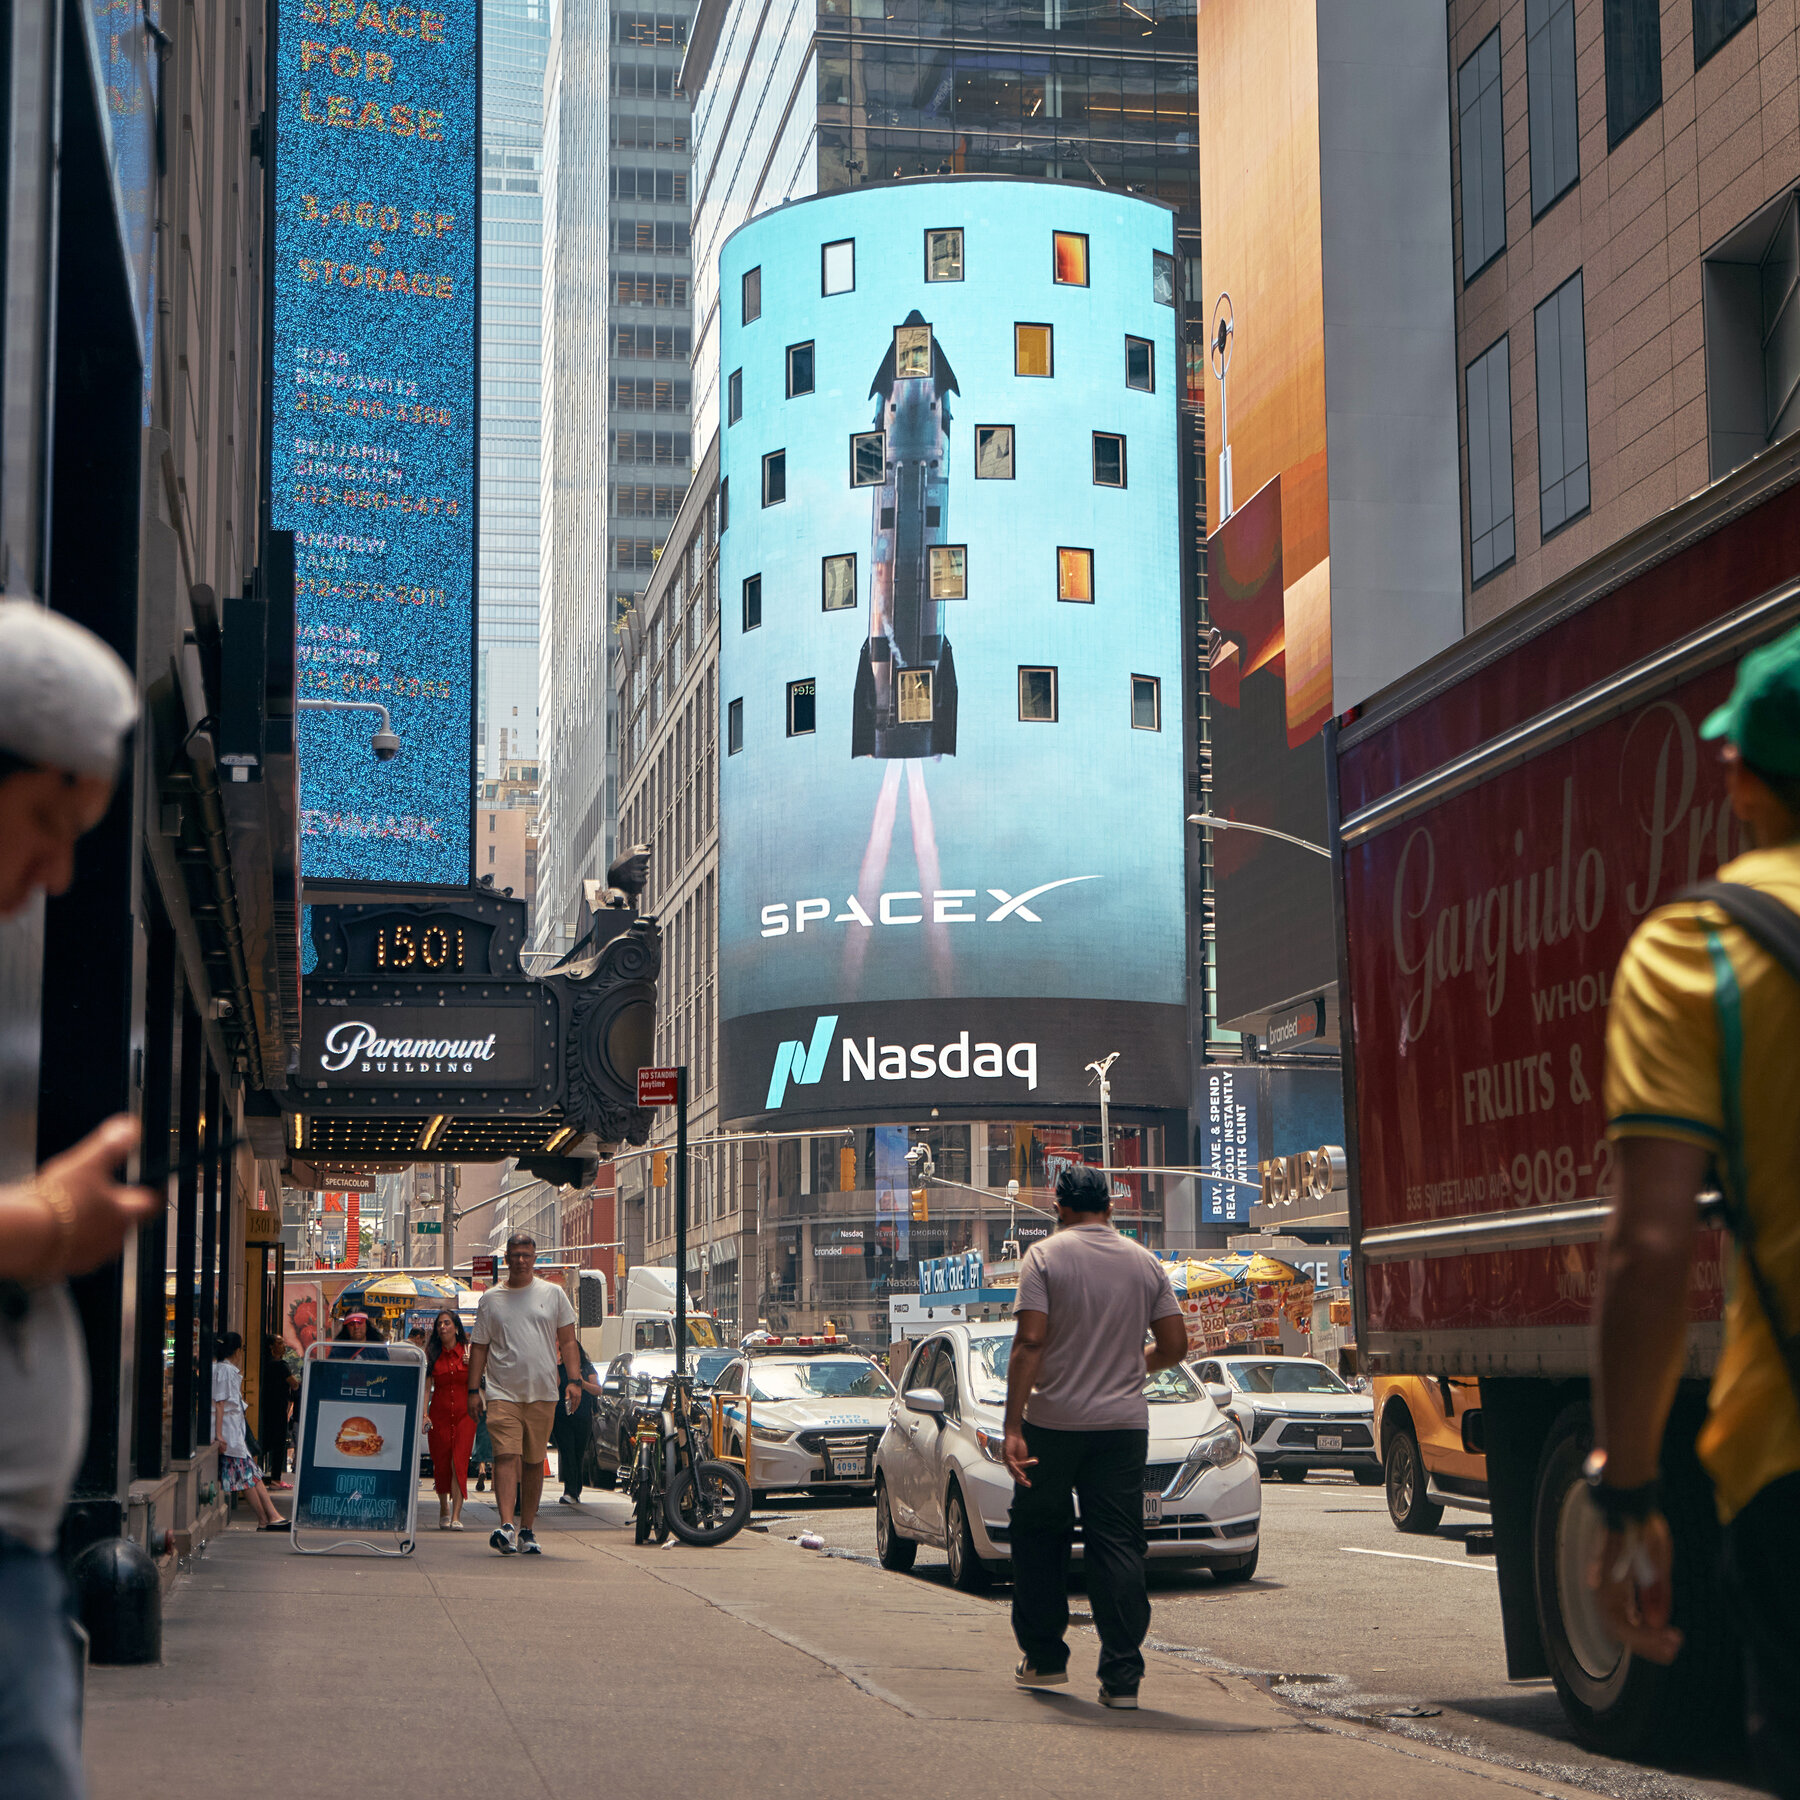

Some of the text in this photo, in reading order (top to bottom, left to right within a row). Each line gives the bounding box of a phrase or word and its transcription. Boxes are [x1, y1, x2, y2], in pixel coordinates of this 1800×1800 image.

[300, 0, 445, 43] SPACE
[300, 41, 393, 84] FOR
[301, 91, 444, 141] LEASE
[413, 212, 454, 238] SF
[299, 258, 453, 299] STORAGE
[295, 368, 419, 397] BERKOWITZ
[294, 437, 400, 463] BENJAMIN
[760, 875, 1104, 938] SPACEX
[377, 925, 464, 968] 1501
[1392, 827, 1606, 1042] Gargiulo
[320, 1021, 496, 1072] Paramount
[362, 1063, 474, 1073] BUILDING
[842, 1031, 1038, 1091] Nasdaq
[641, 1072, 649, 1080] NO
[641, 1081, 665, 1090] Anytime
[1462, 1044, 1591, 1126] FRUITS &
[1210, 1076, 1220, 1122] SPEND
[1211, 1126, 1220, 1135] &
[1223, 1071, 1236, 1220] REAL GOLD INSTANTLY
[1236, 1104, 1248, 1184] WITH GLINT
[325, 1178, 369, 1188] SPECTACOLOR
[1212, 1183, 1223, 1215] BUY,
[423, 1223, 428, 1232] 7
[841, 1230, 864, 1239] Nasdaq
[1018, 1228, 1047, 1237] Nasdaq
[367, 1295, 414, 1305] SABRETT
[1191, 1282, 1233, 1299] SABRETT
[340, 1387, 386, 1398] DELI
[837, 1462, 857, 1471] 4099
[336, 1474, 376, 1495] OPEN
[310, 1496, 397, 1518] BREAKFAST
